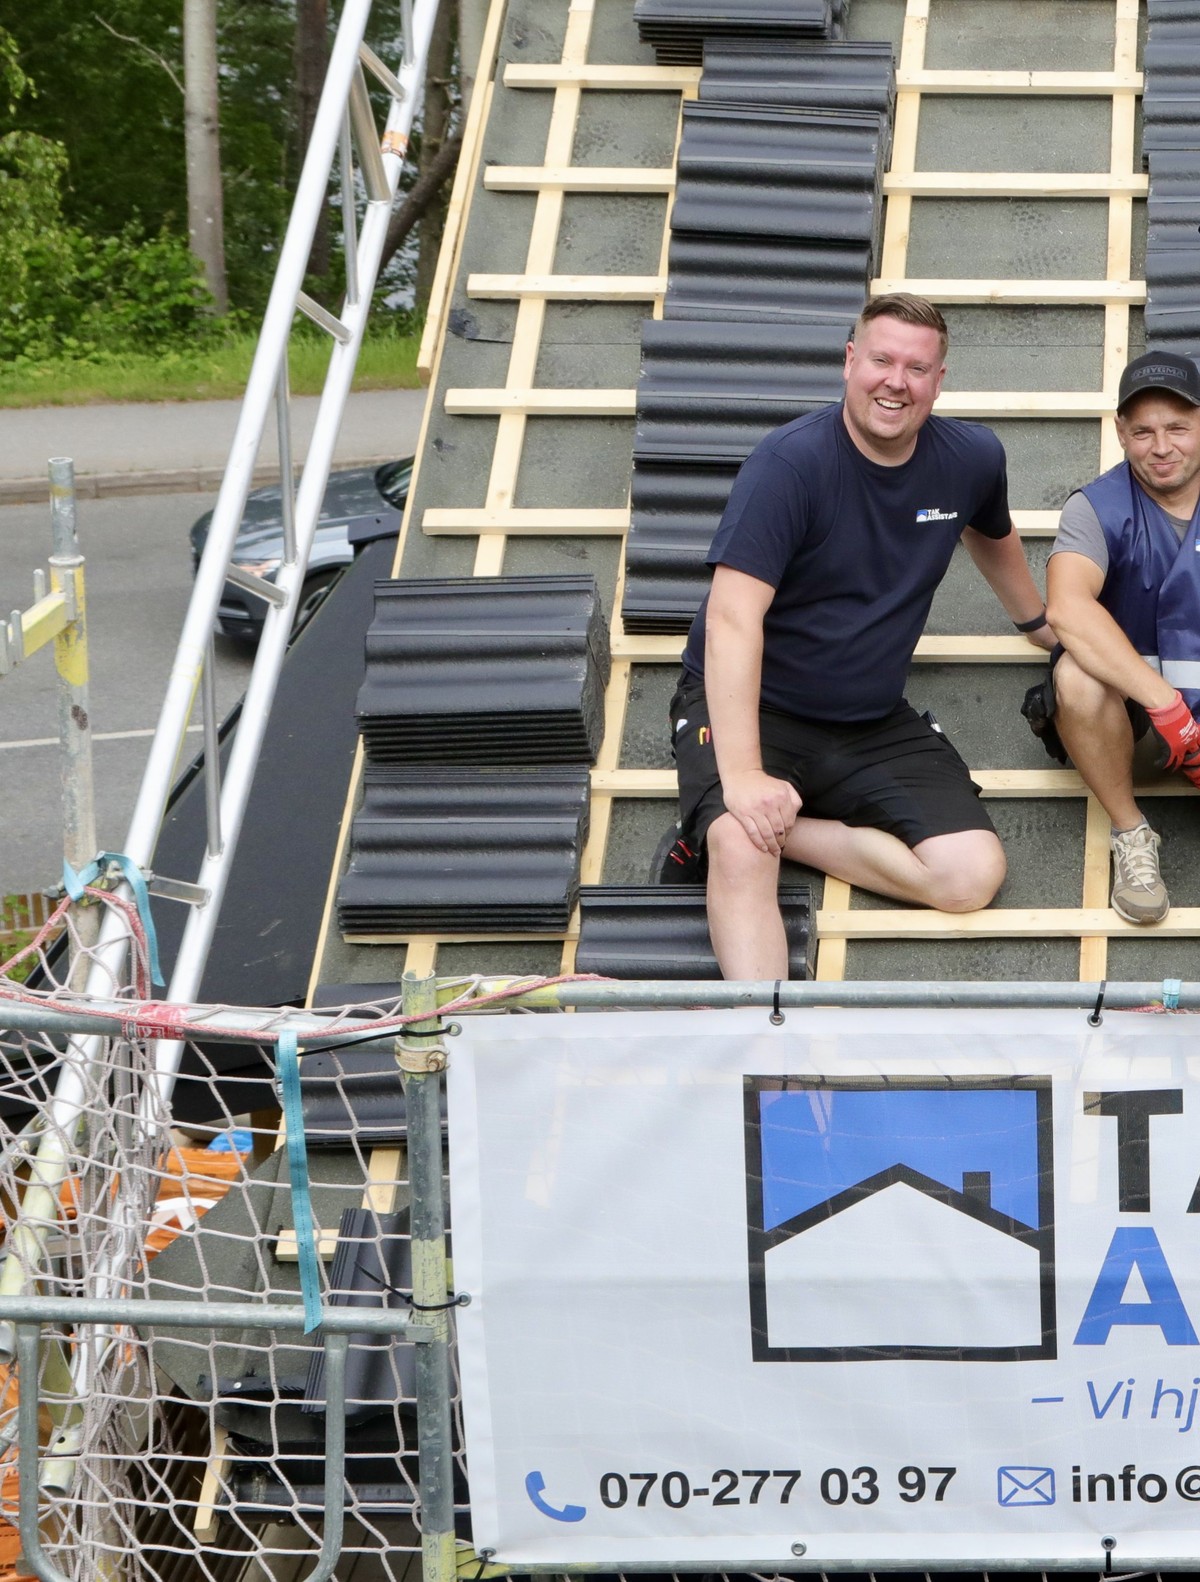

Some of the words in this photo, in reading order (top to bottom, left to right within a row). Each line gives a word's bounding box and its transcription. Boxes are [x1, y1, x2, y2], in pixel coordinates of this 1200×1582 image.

[1142, 366, 1185, 378] BYGMA
[1086, 1377, 1136, 1420] Vi
[599, 1469, 802, 1509] 070-277
[820, 1466, 880, 1506] 03
[897, 1466, 957, 1503] 97
